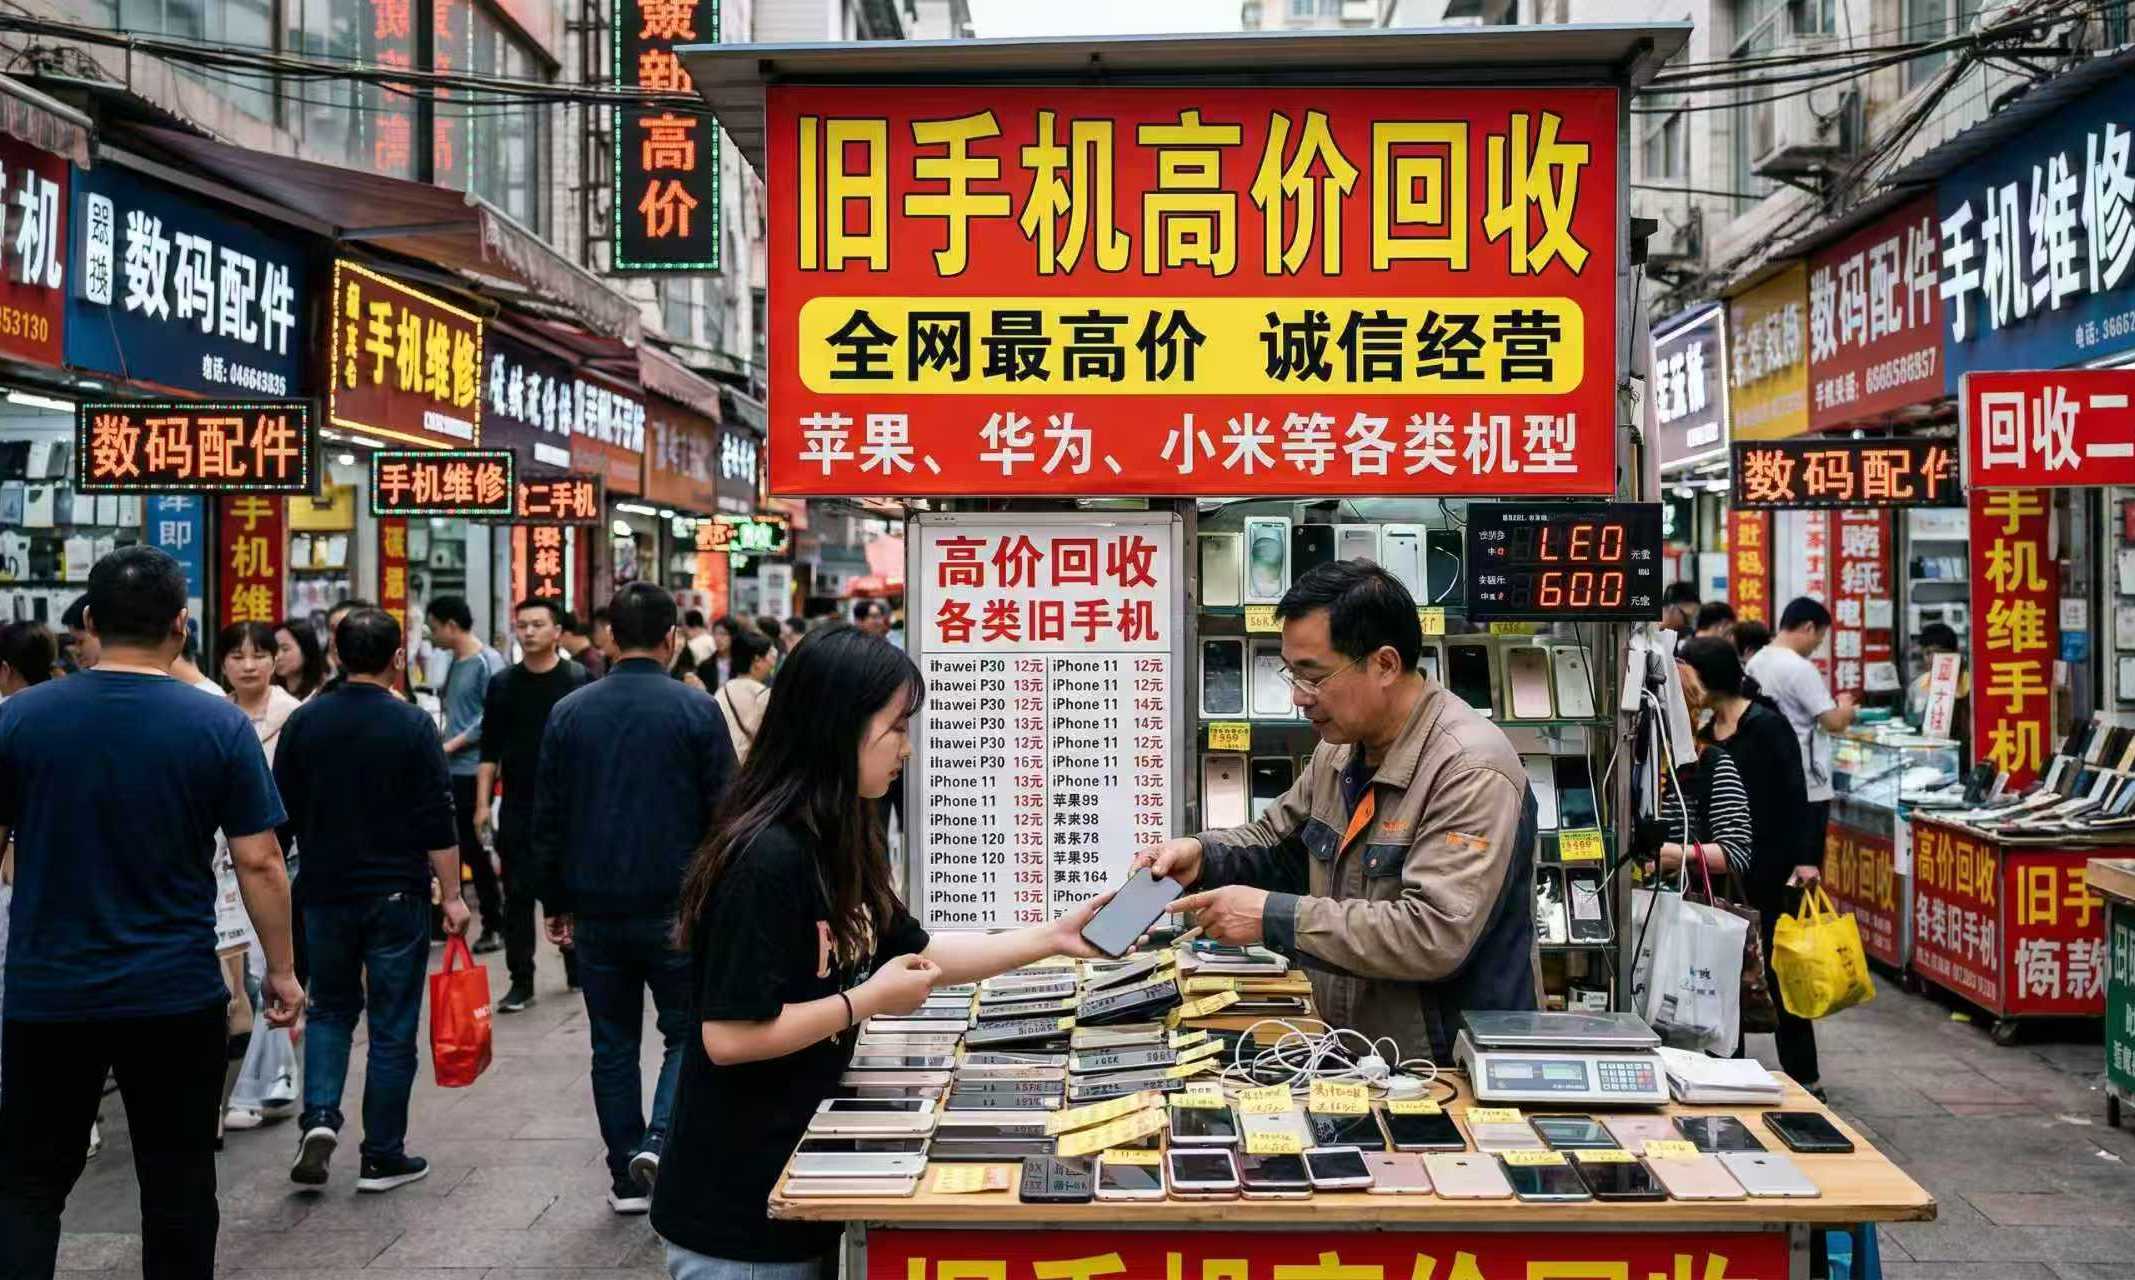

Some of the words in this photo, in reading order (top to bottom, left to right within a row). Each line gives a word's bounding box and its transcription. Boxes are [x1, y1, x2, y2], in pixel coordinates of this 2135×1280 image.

[638, 0, 698, 238] 新高价
[798, 109, 1591, 276] 旧手机高价回收
[1940, 122, 2135, 343] 手机维修
[124, 210, 296, 355] 数码配件
[1811, 217, 1938, 364] 数码配件
[0, 305, 48, 343] 53130
[826, 309, 1207, 381] 全网最高价
[1259, 309, 1561, 381] 诚信经营
[365, 302, 476, 408] 手机维修
[1980, 385, 2134, 472] 回收二
[92, 414, 299, 478] 数码配件
[799, 411, 1579, 477] 苹果、华为、小米等各类机型
[380, 462, 506, 505] 手机维修
[935, 535, 1158, 588] 高价回收
[1539, 572, 1624, 607] 600
[935, 598, 1159, 643] 各类旧手机
[981, 659, 1005, 673] P30
[1014, 659, 1043, 674] 12元
[1053, 659, 1100, 673] iPhone
[1104, 659, 1118, 673] 11
[1134, 659, 1164, 674] 12元
[981, 679, 1005, 692] P30
[1014, 679, 1043, 693] 13元
[1053, 679, 1100, 692] iPhone
[1104, 679, 1118, 692] 11
[1134, 679, 1164, 693] 12元
[981, 698, 1005, 711] P30
[1014, 698, 1043, 712] 12元
[1053, 698, 1100, 711] iPhone
[1104, 698, 1118, 711] 11
[1134, 698, 1164, 712] 14元
[981, 717, 1005, 730] P30
[1014, 717, 1043, 731] 13元
[1053, 717, 1100, 730] iPhone
[1104, 717, 1118, 730] 11
[1134, 717, 1164, 731] 14元
[981, 736, 1005, 750] P30
[1014, 736, 1043, 751] 12元
[1053, 736, 1100, 750] iPhone
[1104, 736, 1118, 750] 11
[1134, 736, 1164, 751] 12元
[981, 755, 1005, 769] P30
[1014, 755, 1043, 770] 16元
[1053, 755, 1100, 769] iPhone
[1104, 755, 1118, 769] 11
[1134, 755, 1164, 770] 15元
[930, 774, 977, 788] iPhone
[981, 774, 996, 788] 11
[1014, 774, 1043, 789] 13元
[1053, 774, 1100, 788] iPhone
[1104, 774, 1118, 788] 11
[1134, 774, 1164, 789] 13元
[930, 793, 977, 807] iPhone
[981, 793, 996, 807] 11
[1014, 793, 1043, 808] 13元
[1134, 793, 1164, 808] 13元
[930, 812, 977, 826] iPhone
[981, 812, 996, 826] 11
[1014, 812, 1043, 827] 12元
[1134, 812, 1164, 827] 13元
[930, 831, 977, 846] iPhone
[981, 831, 1005, 846] 120
[1014, 831, 1043, 847] 13元
[1134, 831, 1164, 847] 13元
[930, 851, 977, 865] iPhone
[981, 851, 1005, 865] 120
[1014, 851, 1043, 866] 13元
[1916, 828, 1996, 907] 高价回收
[930, 870, 977, 884] iPhone
[981, 870, 996, 884] 11
[1014, 870, 1043, 885] 13元
[930, 890, 977, 903] iPhone
[981, 890, 996, 903] 11
[1014, 890, 1043, 904] 13元
[1053, 889, 1100, 902] iPhon
[930, 909, 977, 923] iPhone
[981, 909, 996, 923] 11
[1014, 909, 1043, 924] 13元
[1915, 890, 1997, 971] 各类旧手机
